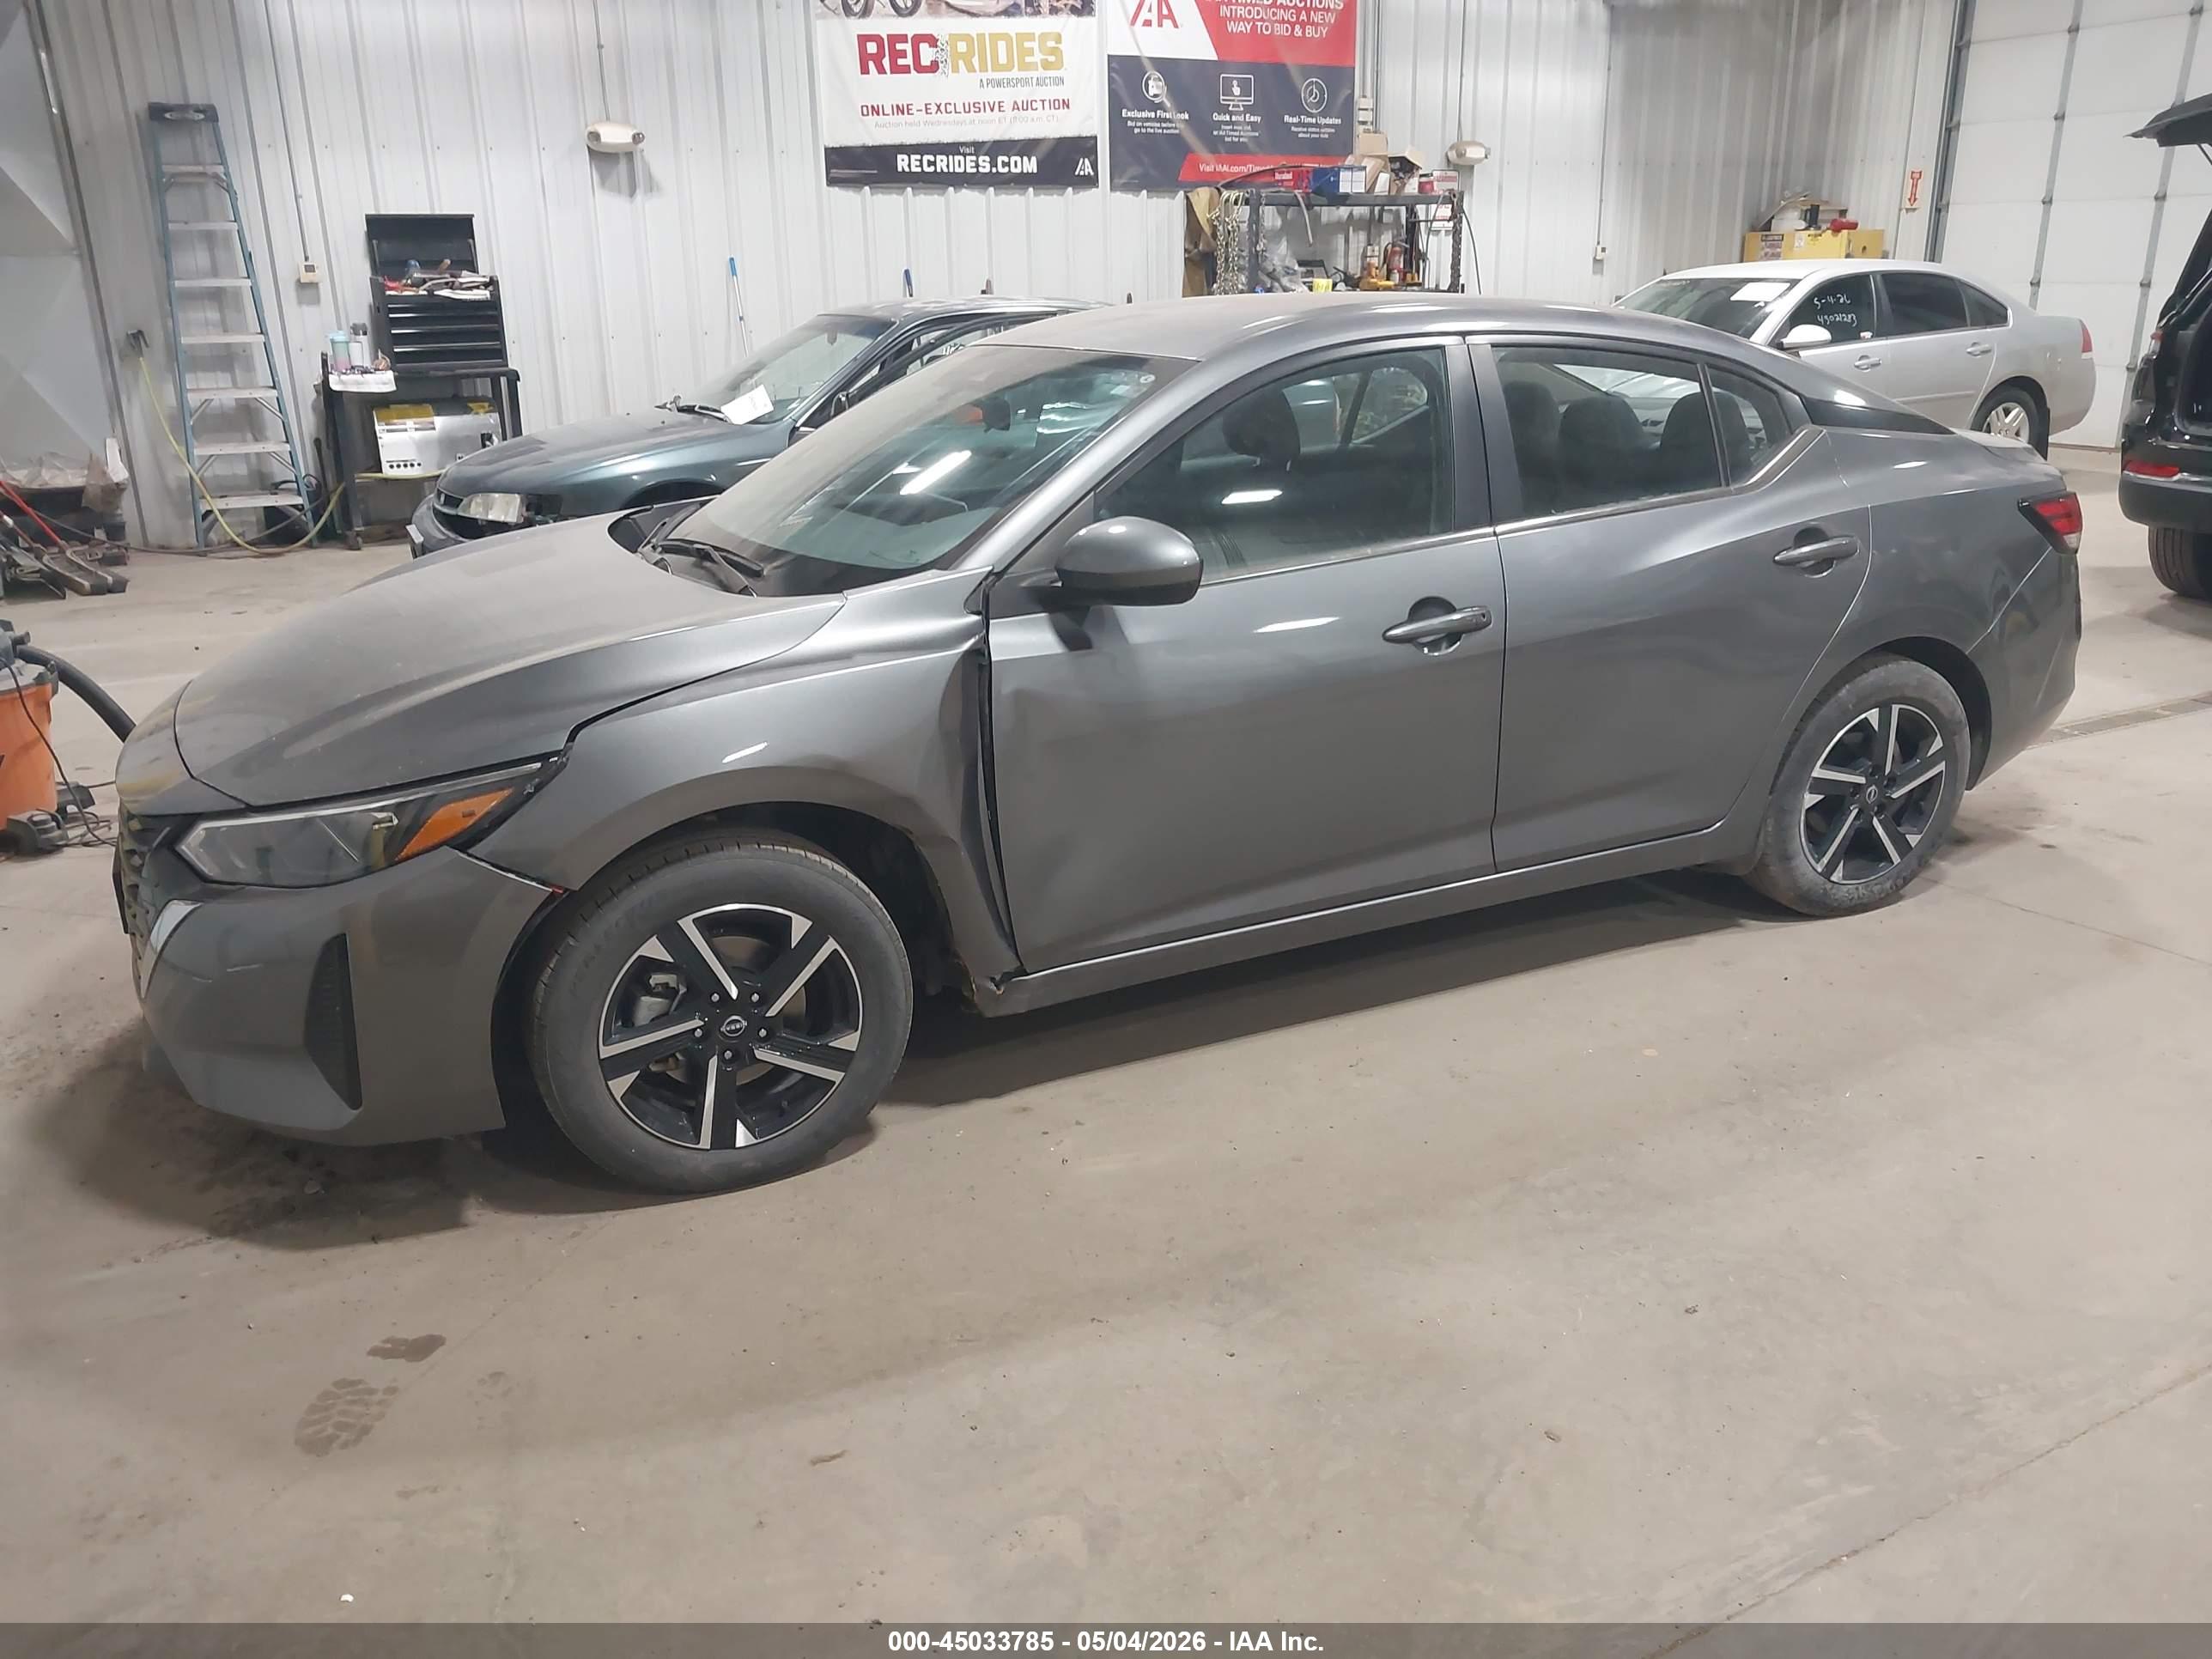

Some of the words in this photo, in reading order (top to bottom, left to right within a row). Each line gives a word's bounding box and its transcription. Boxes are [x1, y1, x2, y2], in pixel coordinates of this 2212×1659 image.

[1219, 5, 1297, 21] INTRODUCING
[1299, 10, 1308, 21] A
[1310, 11, 1336, 24] NEW
[1226, 20, 1253, 33] WAY
[1255, 21, 1272, 34] TO
[1274, 23, 1291, 36] BID
[1293, 25, 1303, 37] &
[1305, 26, 1328, 38] BUY
[979, 78, 985, 89] A
[986, 76, 1035, 89] POWERSPORT
[1036, 76, 1065, 88] AUCTION
[860, 100, 1006, 117] ONLINE-EXCLUSIVE
[1012, 98, 1071, 112] AUCTION
[1121, 108, 1156, 118] Exclusive
[1157, 110, 1172, 118] First
[874, 120, 902, 129] Auction
[922, 118, 967, 128] Wednesdays
[1212, 112, 1231, 122] Quick
[1231, 113, 1244, 122] and
[1245, 113, 1261, 125] Easy
[1284, 114, 1316, 124] Real-Time
[1317, 116, 1342, 125] Updates
[959, 145, 975, 154] Visit
[896, 153, 1038, 174] RECRIDES.COM
[1199, 163, 1214, 173] Visit
